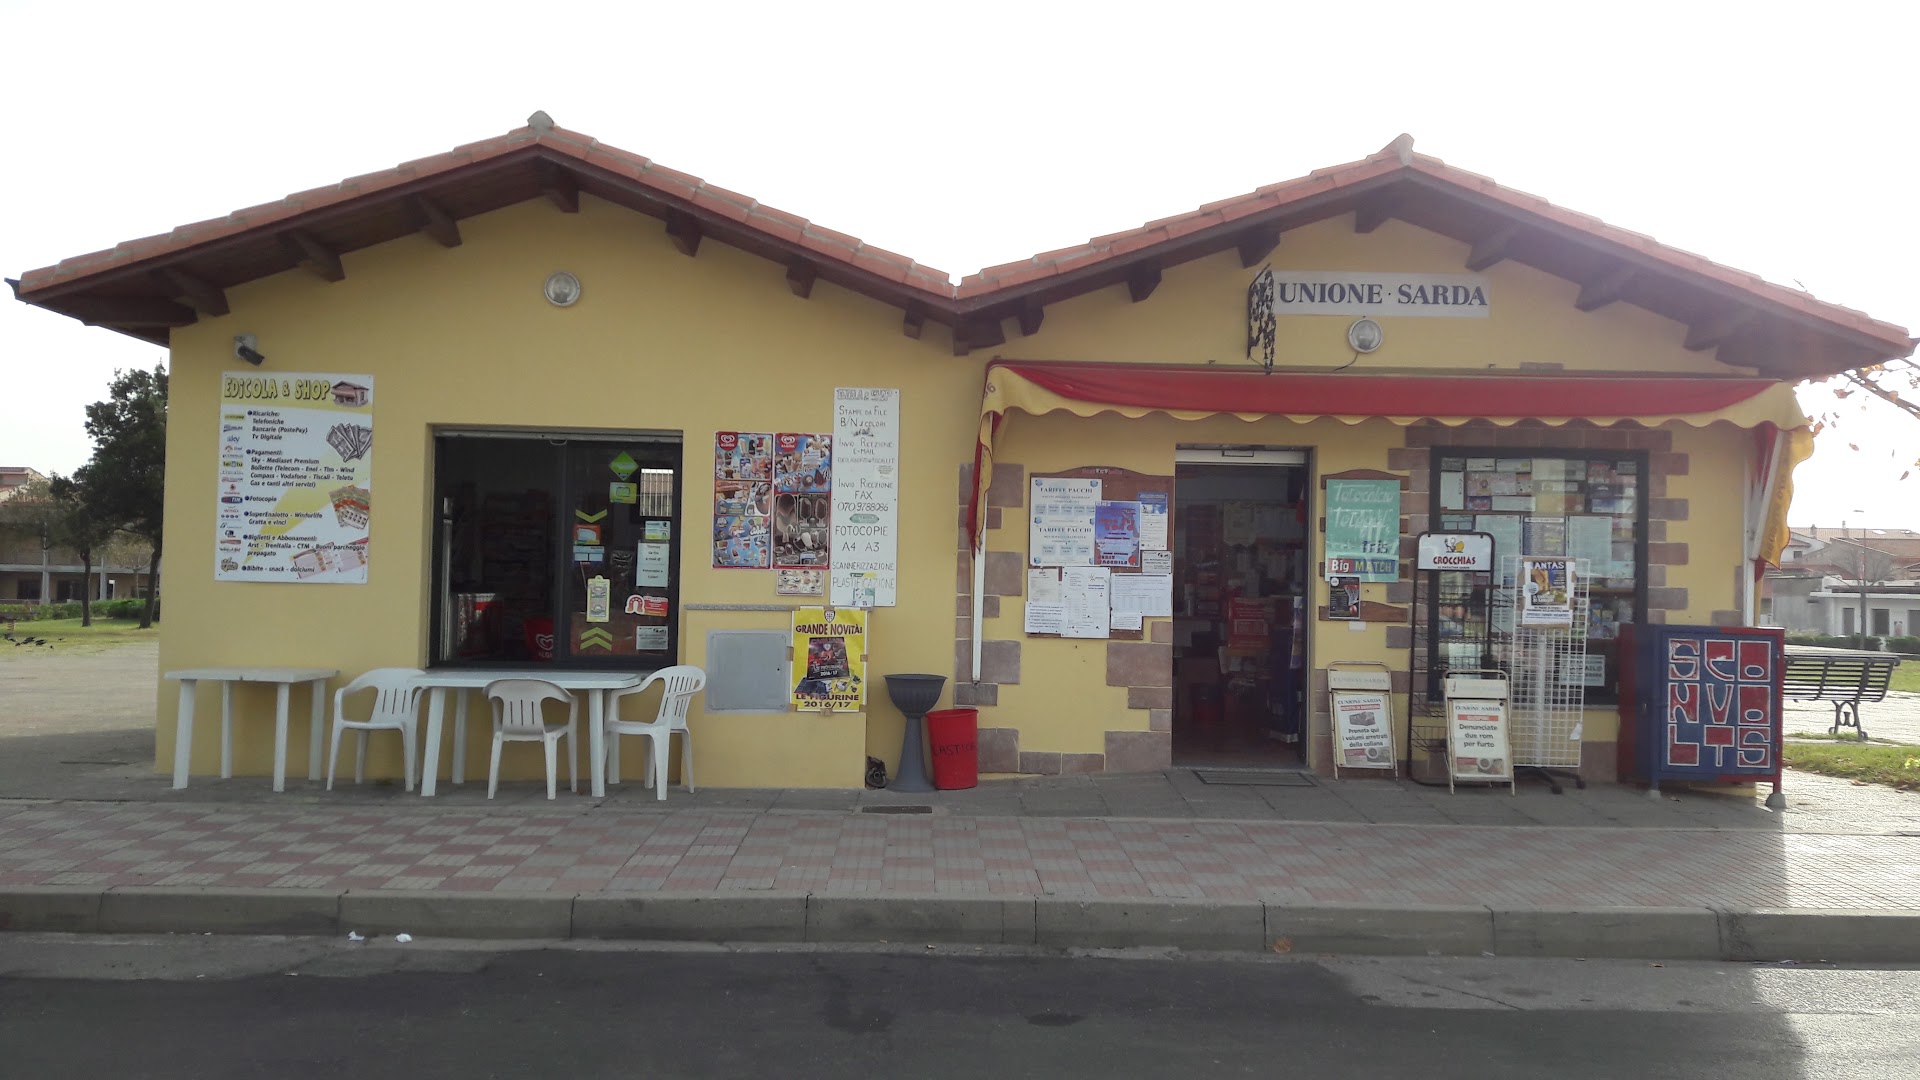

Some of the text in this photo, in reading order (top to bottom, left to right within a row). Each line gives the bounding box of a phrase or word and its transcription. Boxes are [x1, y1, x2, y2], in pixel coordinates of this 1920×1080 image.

[1397, 283, 1488, 306] SARDA
[282, 380, 290, 397] &
[295, 379, 331, 400] SHOP
[840, 417, 858, 427] B/N
[839, 478, 893, 489] INVIO RICEZIONE
[854, 490, 873, 500] FAX
[835, 525, 888, 536] FOTOCOPIE
[842, 541, 880, 552] A4 A3
[832, 561, 894, 571] SCANNERIZZAZIONE
[1433, 556, 1476, 565] CROCCHIAS
[1331, 560, 1392, 573] Big MATCH
[832, 577, 894, 588] PLASTIFICAZIONE
[795, 624, 828, 635] GRANDE
[1459, 723, 1498, 731] Denunciate
